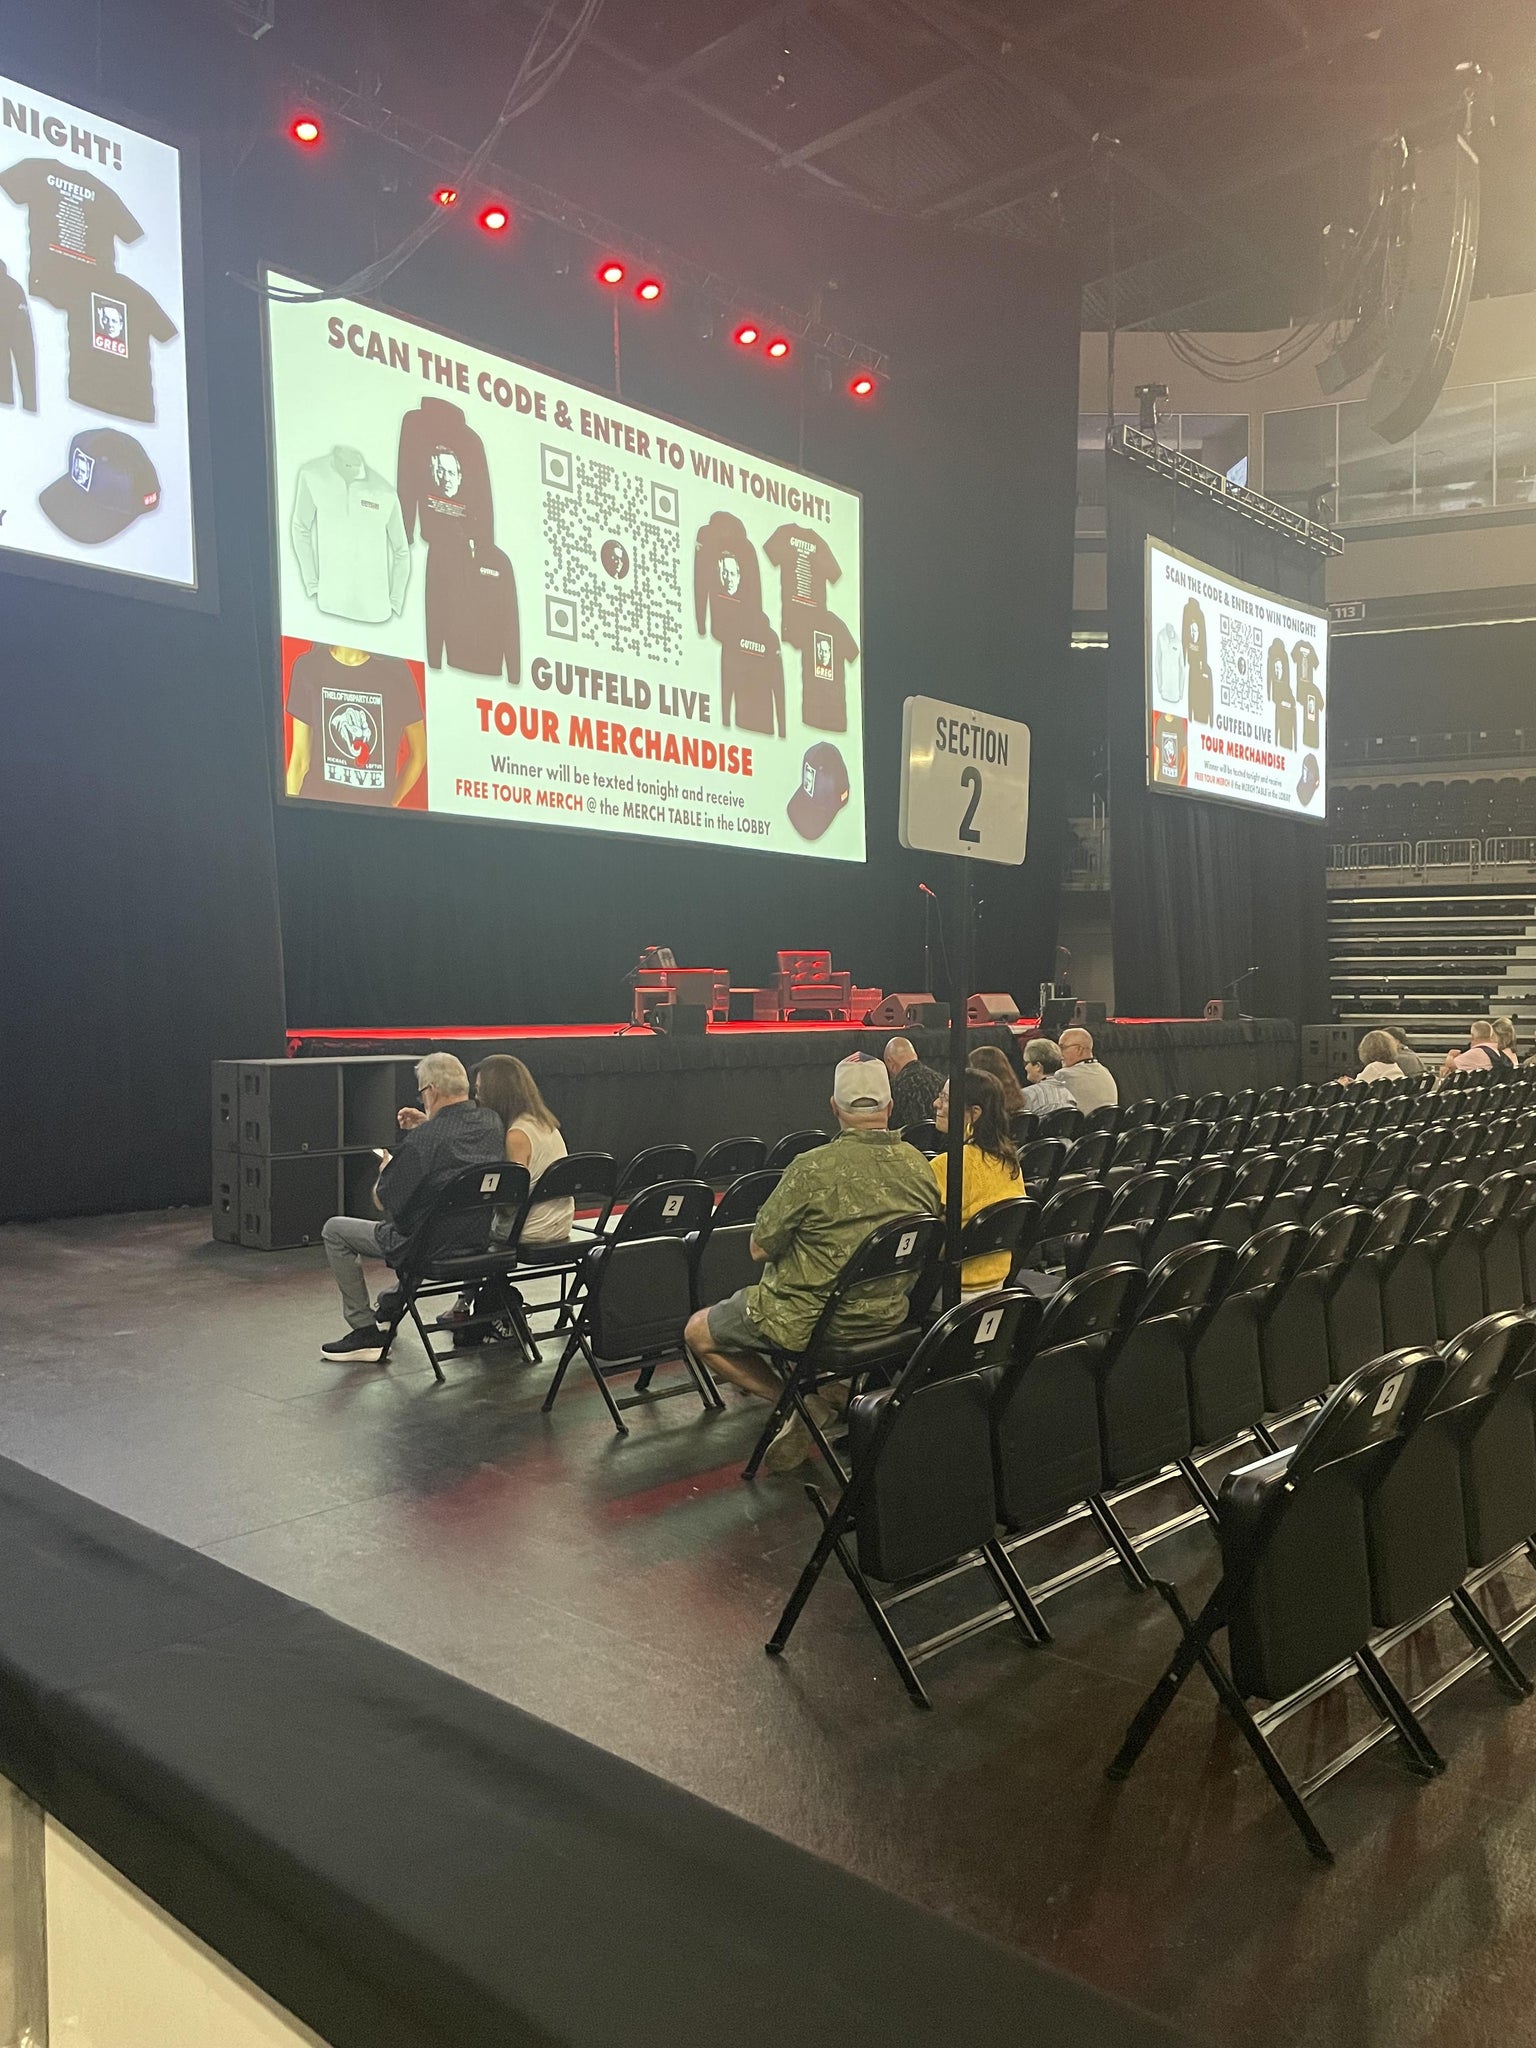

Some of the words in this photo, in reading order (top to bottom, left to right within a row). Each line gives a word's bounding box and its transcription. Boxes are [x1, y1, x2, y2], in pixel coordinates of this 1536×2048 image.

[2, 96, 122, 171] NIGHT!
[95, 335, 126, 355] GREG
[327, 316, 410, 373] SCAN
[417, 347, 470, 395] THE
[477, 371, 547, 422] CODE
[553, 400, 575, 432] &
[580, 407, 652, 460] ENTER
[656, 436, 685, 470] TO
[689, 449, 735, 489] WIN
[739, 467, 832, 524] TONIGHT!
[1165, 564, 1186, 588] SCAN
[1187, 575, 1202, 598] THE
[1202, 582, 1222, 603] CODE
[1224, 592, 1231, 607] &
[1231, 594, 1254, 617] ENTER
[1255, 604, 1265, 620] TO
[1266, 608, 1281, 626] WIN
[1282, 615, 1317, 638] TONIGHT!
[1335, 606, 1356, 618] 113
[531, 657, 651, 710] GUTFELD
[659, 683, 711, 723] LIVE
[476, 698, 560, 744] TOUR
[568, 715, 753, 777] MERCHANDISE
[935, 716, 1009, 767] SECTION
[1216, 713, 1252, 738] GUTFELD
[1254, 725, 1272, 744] LIVE
[1201, 734, 1224, 755] TOUR
[1226, 741, 1285, 771] MERCHANDISE
[327, 765, 382, 787] LIVE
[491, 755, 543, 779] Winner
[547, 764, 570, 784] will
[574, 765, 590, 786] be
[593, 771, 634, 792] texted
[637, 777, 679, 802] tonight
[682, 783, 703, 803] and
[706, 791, 745, 808] receive
[455, 778, 489, 799] FREE
[492, 783, 532, 805] TOUR
[536, 790, 583, 812] MERCH
[586, 796, 597, 814] @
[600, 798, 619, 816] the
[623, 801, 665, 823] MERCH
[668, 807, 702, 827] TABLE
[704, 812, 714, 828] in
[717, 813, 734, 832] the
[737, 817, 771, 836] LOBBY
[958, 766, 983, 843] 2
[488, 1177, 494, 1187] 1
[669, 1200, 677, 1211] 2
[902, 1237, 911, 1250] 3
[986, 1317, 994, 1335] 1
[1382, 1384, 1395, 1405] 2
